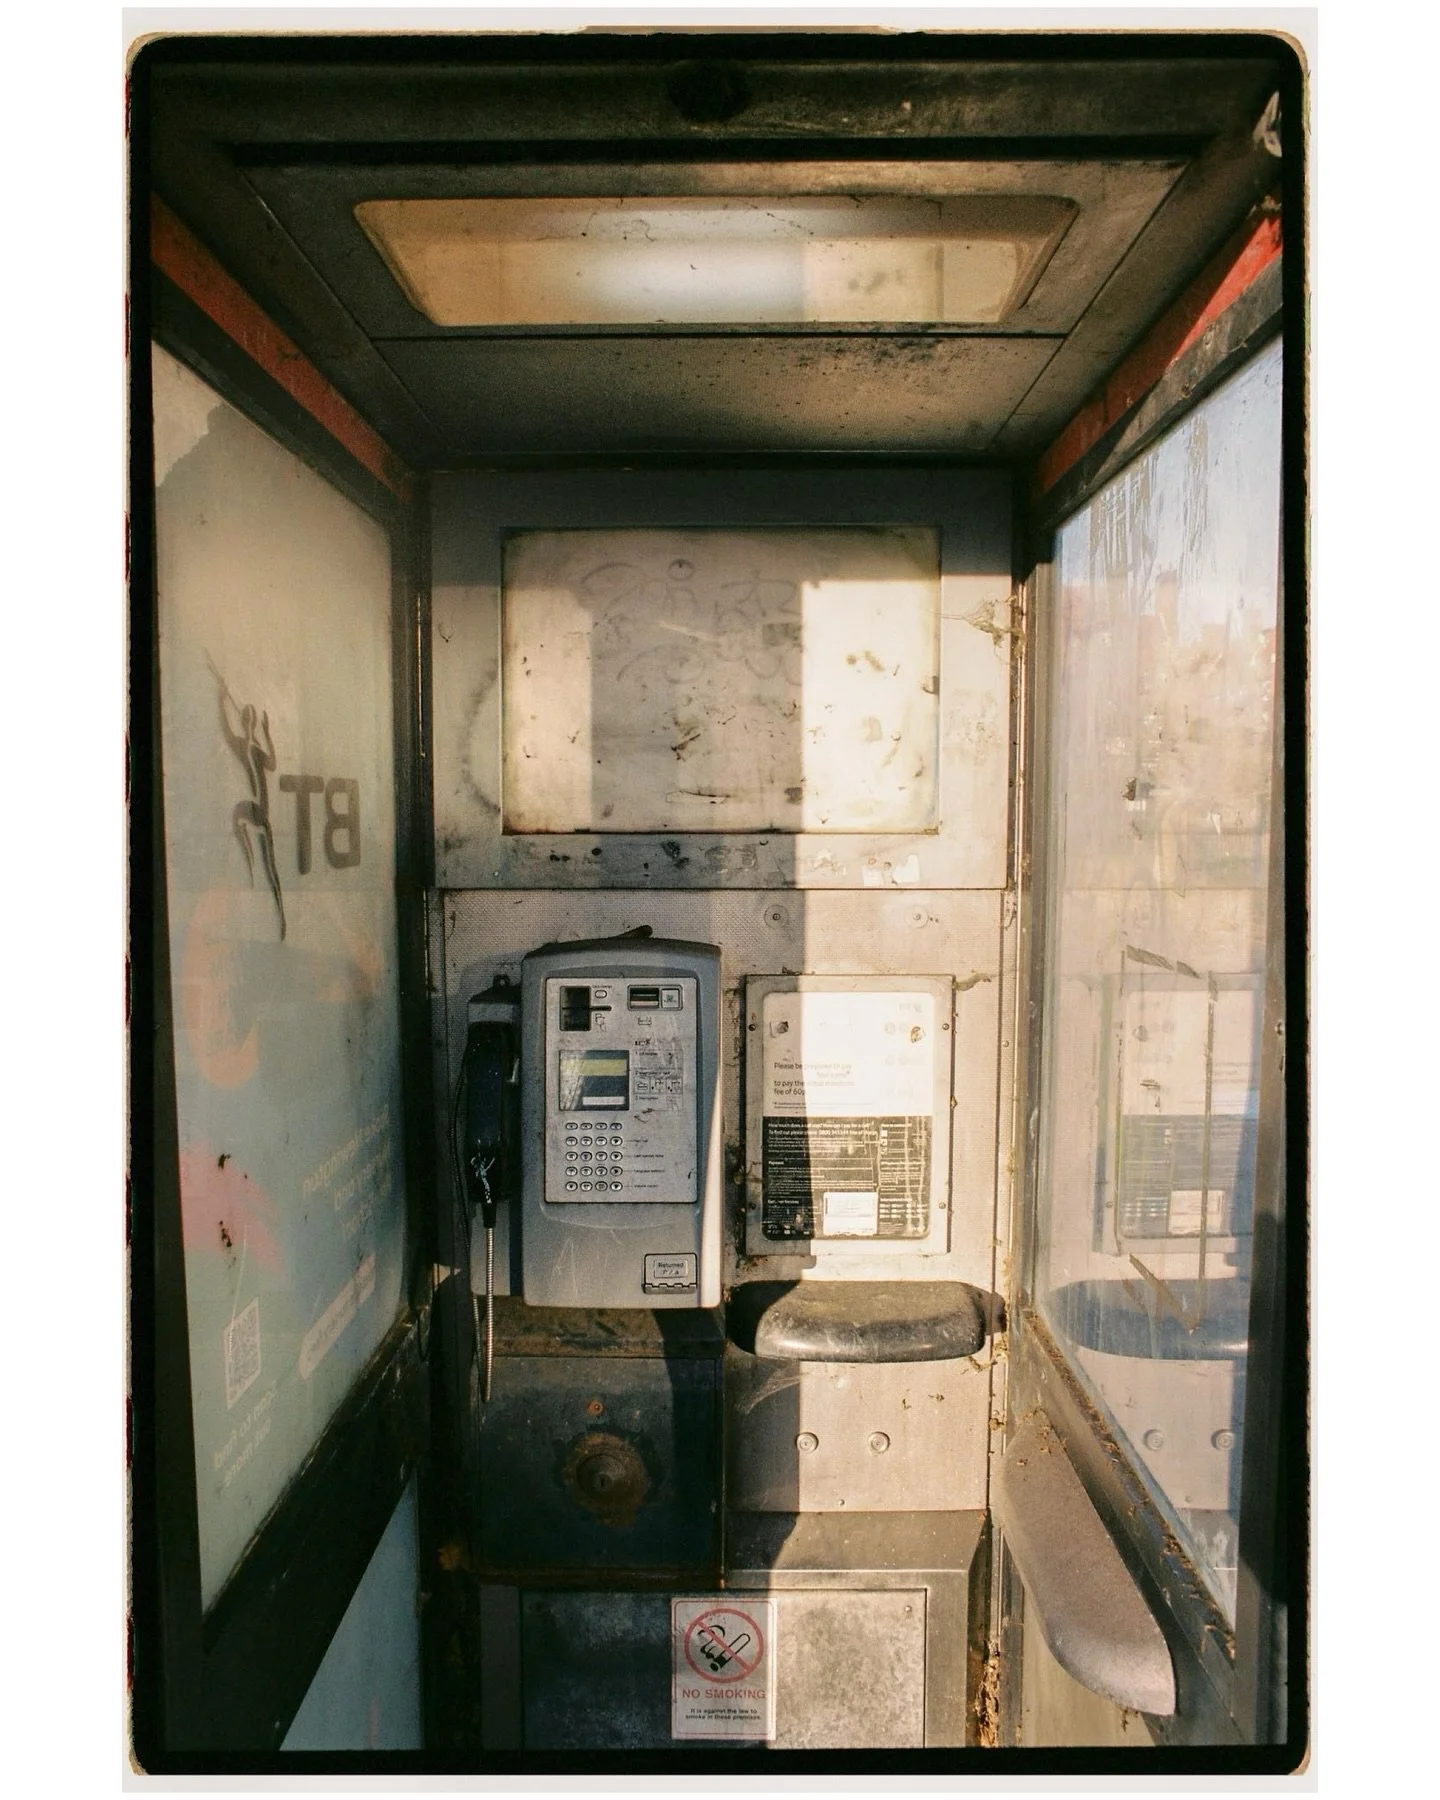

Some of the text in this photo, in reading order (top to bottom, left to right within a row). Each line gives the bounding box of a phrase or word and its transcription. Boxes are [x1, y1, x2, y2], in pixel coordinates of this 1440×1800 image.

[773, 1062, 794, 1070] Please
[795, 1062, 803, 1070] be
[773, 1088, 785, 1096] fee
[785, 1088, 792, 1096] of
[682, 1688, 766, 1699] NO SMOKING
[704, 1708, 726, 1716] against
